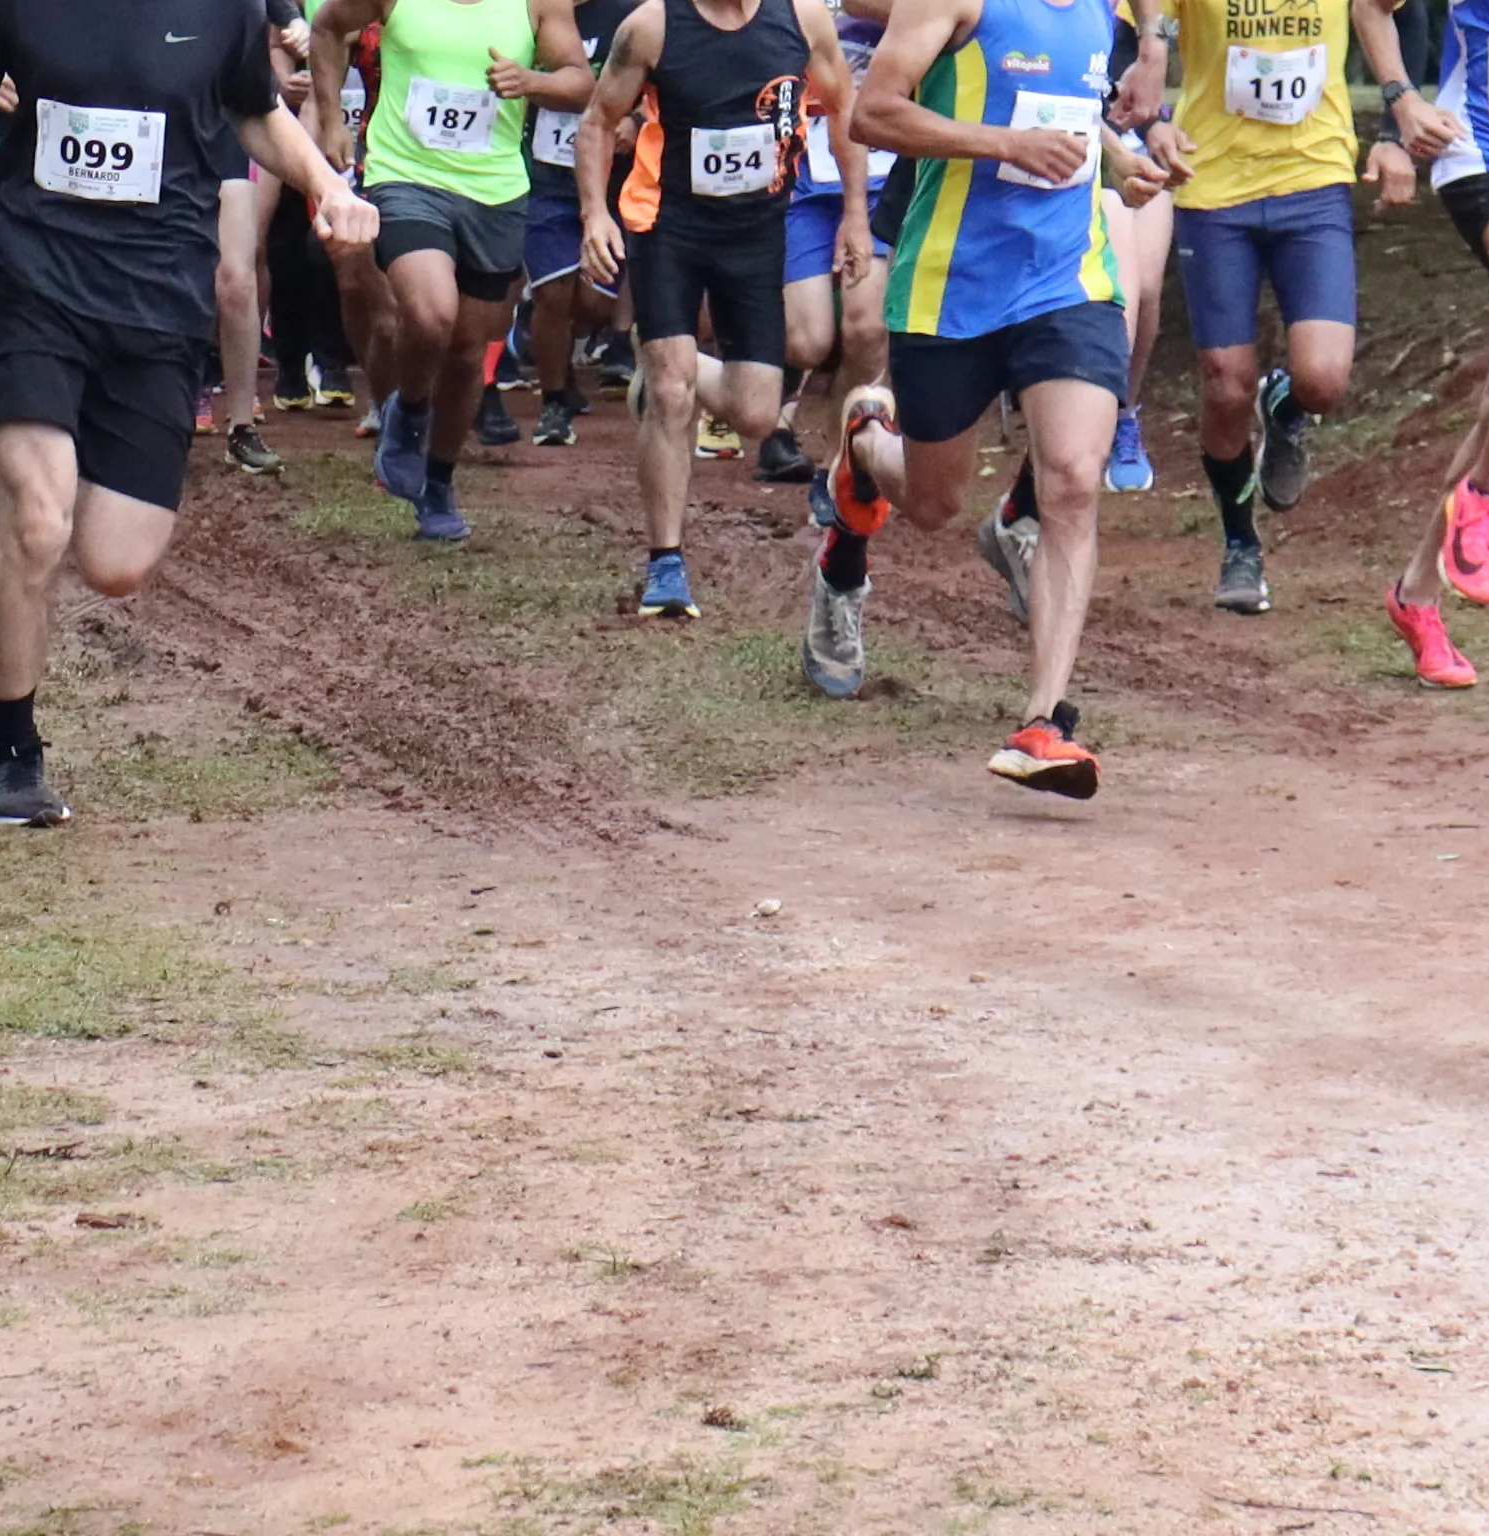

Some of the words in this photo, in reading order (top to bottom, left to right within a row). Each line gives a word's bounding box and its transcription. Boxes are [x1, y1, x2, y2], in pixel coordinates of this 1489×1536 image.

[1227, 16, 1323, 39] RUNNERS
[1250, 76, 1306, 101] 110
[426, 106, 477, 131] 187
[60, 135, 133, 171] 099
[703, 150, 763, 174] 054
[68, 166, 120, 182] BERNARDO
